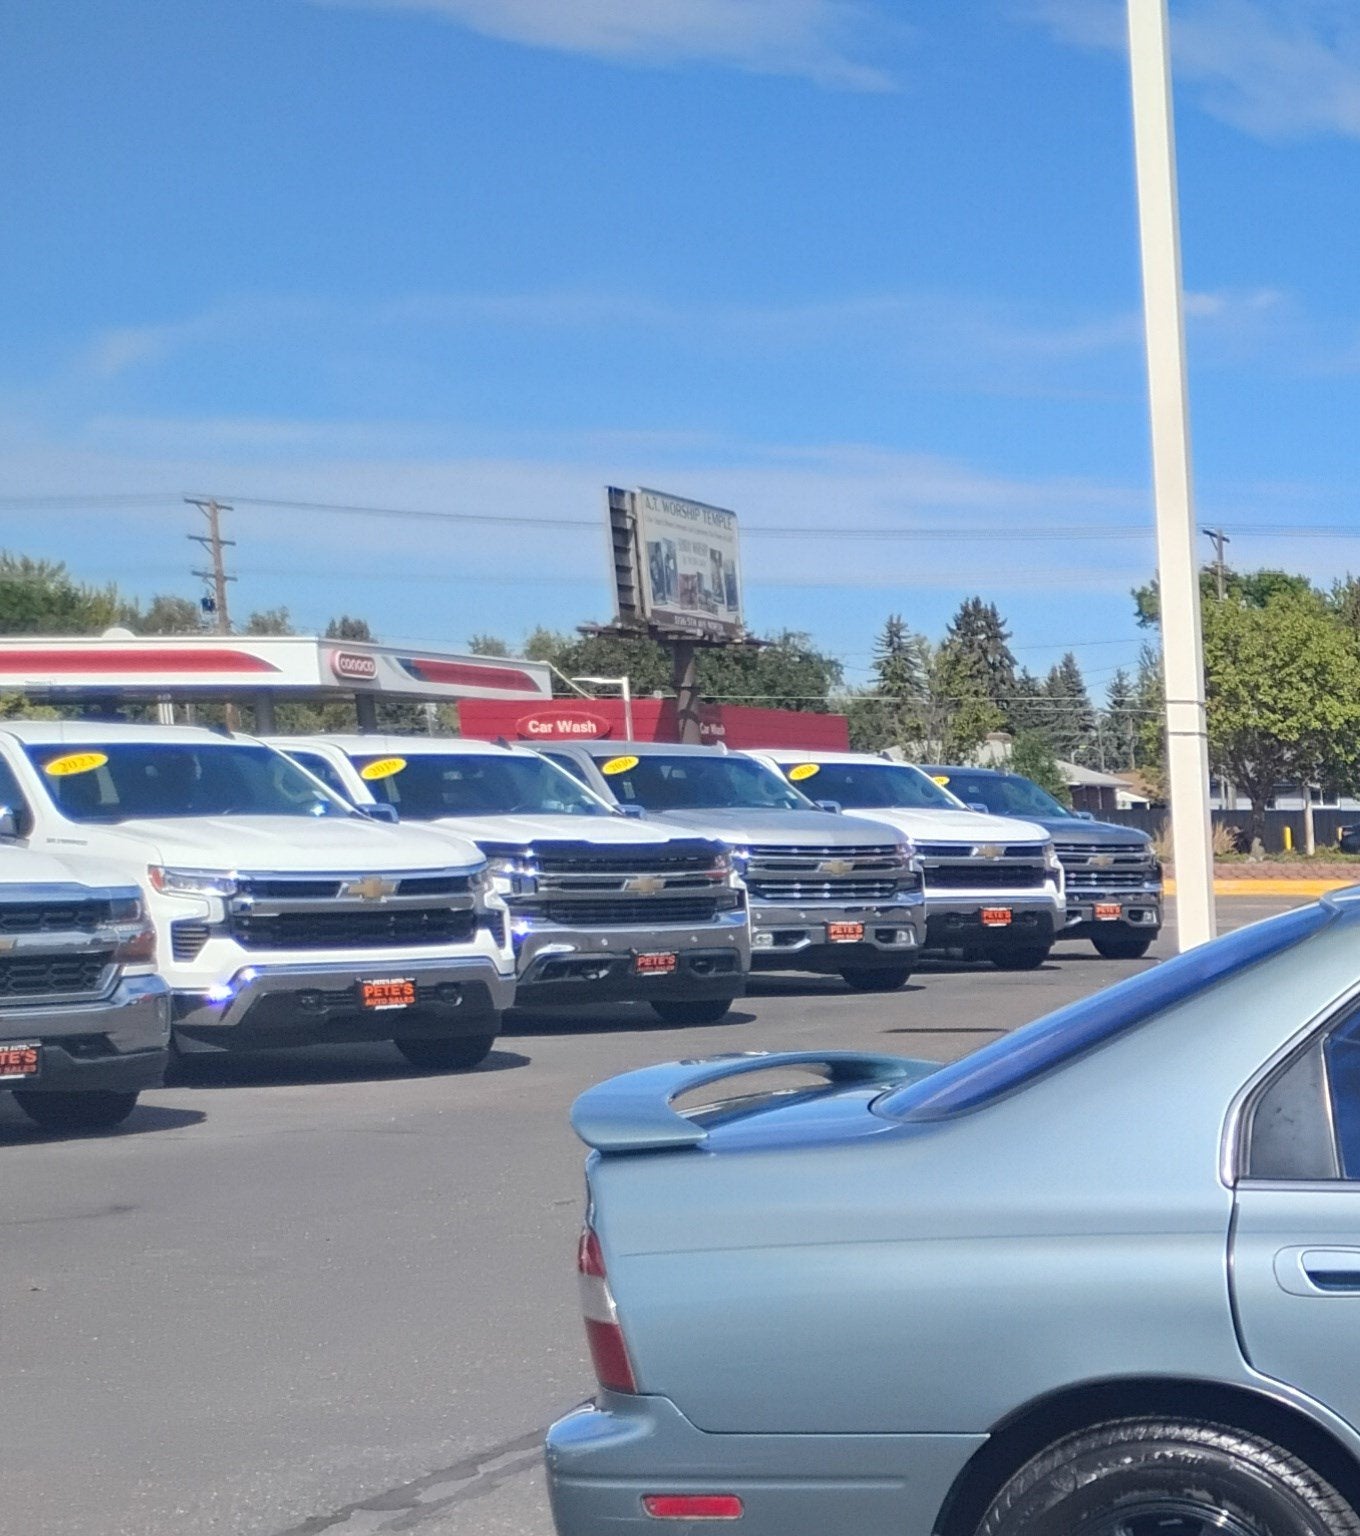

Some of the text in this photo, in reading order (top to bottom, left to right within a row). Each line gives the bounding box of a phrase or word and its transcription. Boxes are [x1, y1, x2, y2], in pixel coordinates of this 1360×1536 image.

[662, 500, 700, 520] WORSHIP
[703, 509, 733, 531] TEMPLE
[528, 720, 597, 733] Car Wash
[364, 982, 414, 997] PETE'S
